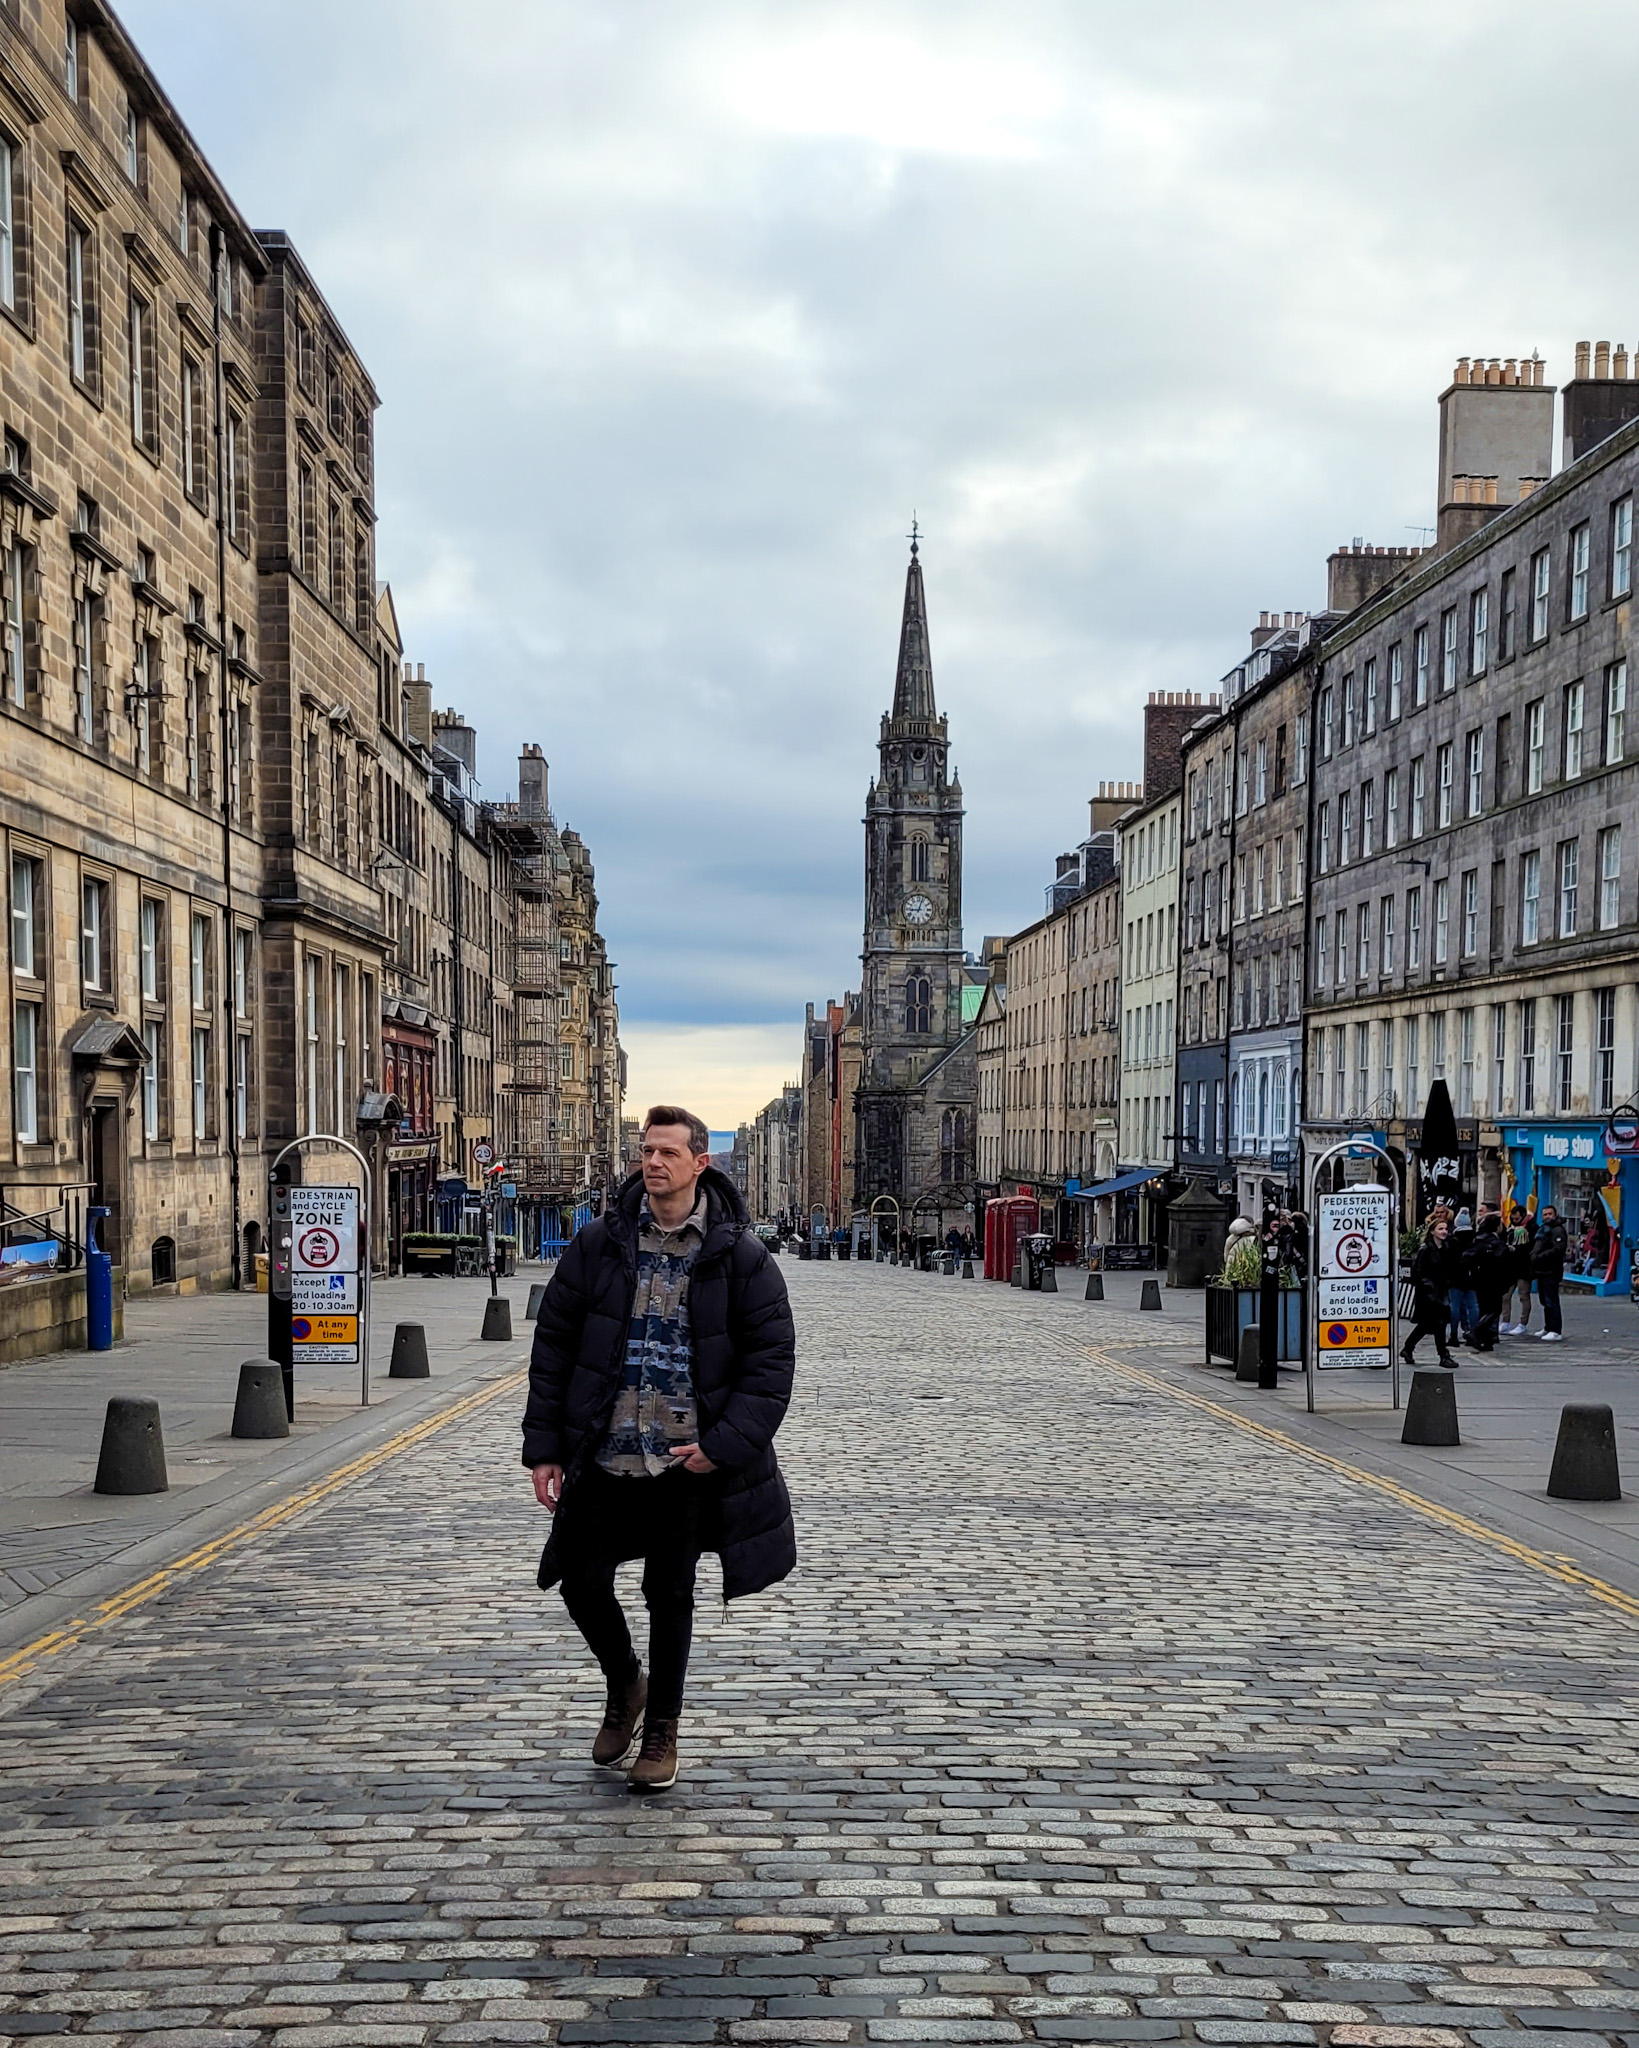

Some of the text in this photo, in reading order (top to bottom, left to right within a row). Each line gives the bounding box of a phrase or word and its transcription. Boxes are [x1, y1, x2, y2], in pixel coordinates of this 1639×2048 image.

[1544, 1134, 1570, 1160] fringe
[1572, 1135, 1594, 1160] shop
[476, 1149, 491, 1158] 20
[1273, 1154, 1288, 1164] 166
[292, 1191, 353, 1200] EDESTRIAN
[1324, 1196, 1384, 1206] PEDESTRIAN
[292, 1202, 346, 1210] and CYCLE
[1329, 1207, 1378, 1216] and CYCLE
[295, 1212, 343, 1225] ZONE
[1332, 1218, 1376, 1230] ZONE
[293, 1278, 326, 1287] Except
[1330, 1284, 1360, 1292] Except
[292, 1291, 346, 1300] and loading
[1329, 1295, 1379, 1305] and loading
[331, 1322, 348, 1330] any
[1353, 1325, 1381, 1334] At any
[322, 1331, 344, 1339] time
[1358, 1336, 1377, 1344] time
